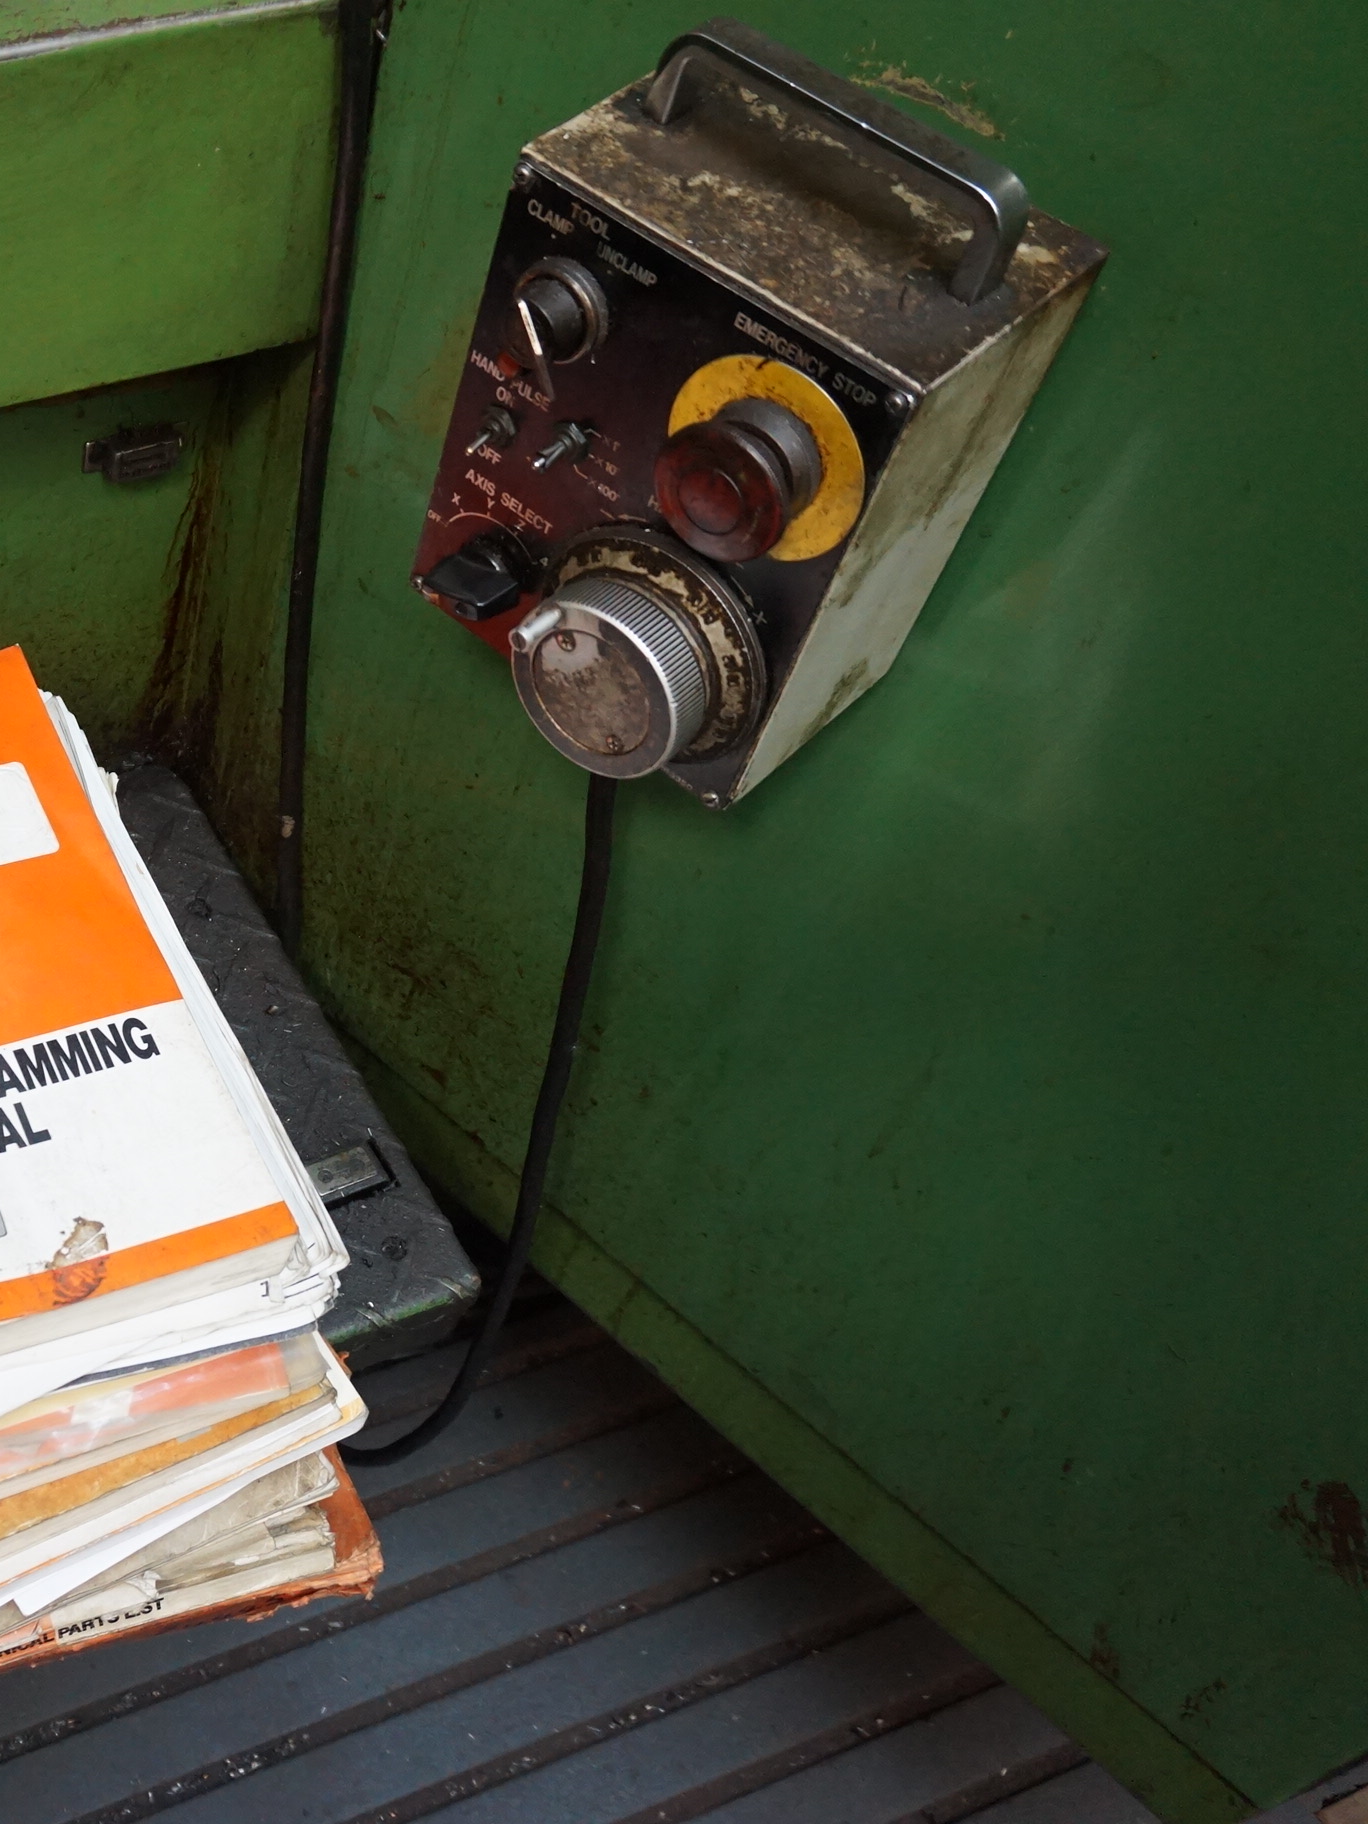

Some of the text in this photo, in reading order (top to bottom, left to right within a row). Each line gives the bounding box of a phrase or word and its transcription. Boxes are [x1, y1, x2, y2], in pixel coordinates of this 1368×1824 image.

[527, 198, 575, 236] CLAMP
[571, 201, 611, 241] TOOL
[596, 240, 658, 288] UNCLAMP
[470, 350, 506, 383] HAND
[733, 310, 878, 407] EMERGENCY STOP
[495, 386, 516, 408] ON
[451, 491, 461, 506] X
[464, 468, 553, 535] AXIS SELECT
[486, 496, 495, 509] Y
